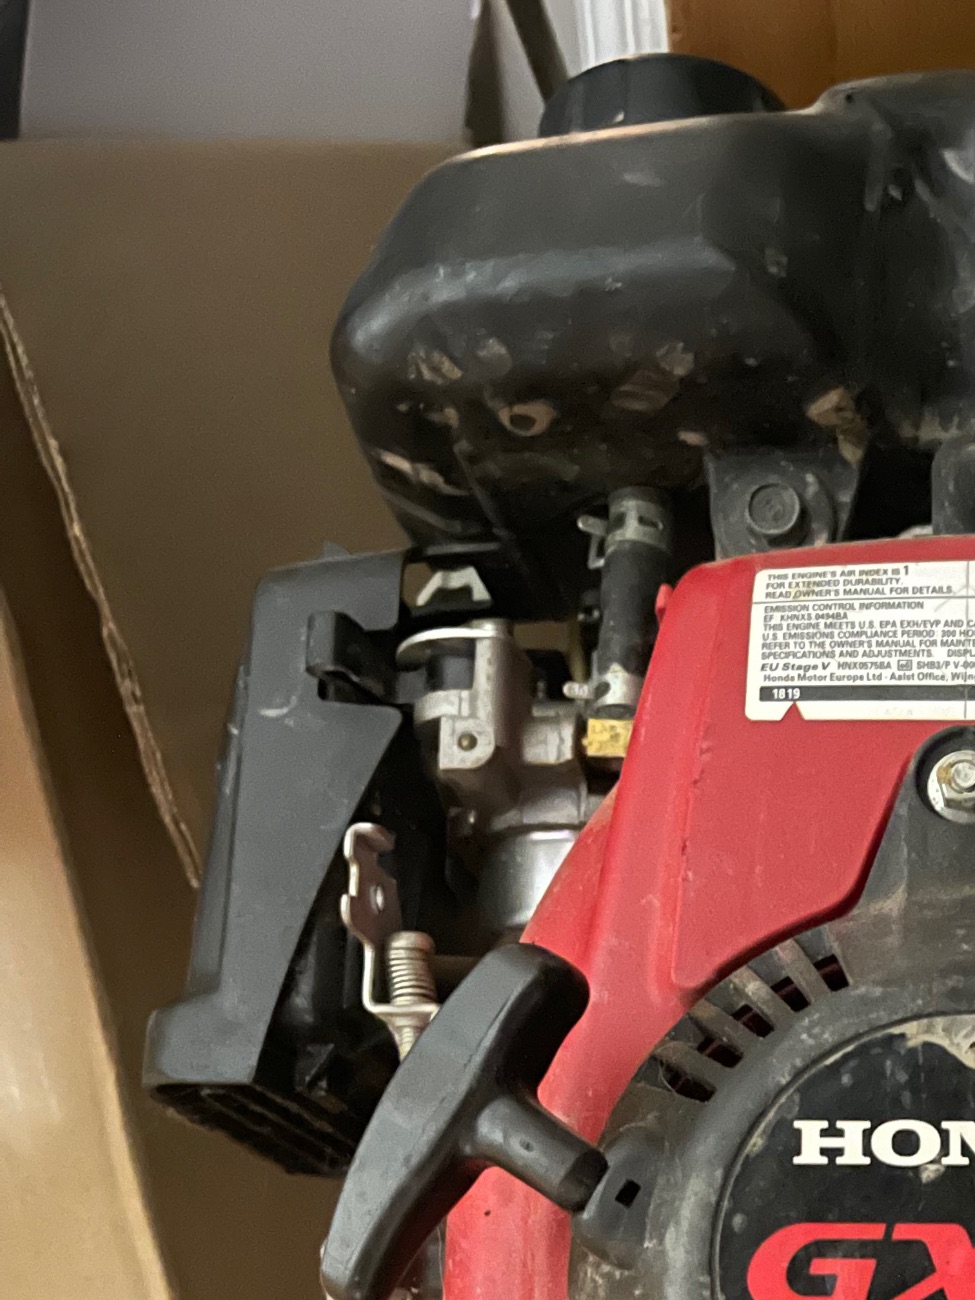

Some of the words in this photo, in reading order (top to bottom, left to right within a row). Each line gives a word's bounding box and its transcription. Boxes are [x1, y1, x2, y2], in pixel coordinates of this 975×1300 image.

[791, 570, 837, 580] ENGINE'S
[839, 570, 856, 578] AIR
[858, 568, 888, 577] INDEX
[891, 568, 900, 576] IS
[903, 565, 909, 575] 1
[766, 582, 785, 590] FOR
[788, 579, 840, 589] EXTENDED
[765, 591, 791, 599] READ
[792, 589, 840, 599] OWNER'S
[843, 587, 886, 596] MANUAL
[889, 586, 909, 595] FOR
[764, 604, 809, 613] EMISSION
[812, 602, 856, 611] CONTROL
[859, 601, 924, 610] INFORMATION
[763, 623, 783, 631] THIS
[786, 622, 821, 631] ENGINE
[824, 621, 855, 629] MEETS
[879, 620, 897, 628] EPA
[900, 619, 941, 628] EXH/EVP
[943, 619, 964, 628] AND
[783, 631, 835, 640] EMISSIONS
[838, 630, 898, 639] COMPLIANCE
[761, 641, 790, 650] REFER
[793, 640, 805, 649] TO
[809, 640, 826, 649] THE
[829, 640, 872, 649] OWNER'S
[875, 639, 916, 648] MANUAL
[919, 639, 938, 648] FOR
[761, 650, 836, 660] SPECIFICATIONS
[838, 650, 859, 658] AND
[760, 662, 779, 672] EU
[782, 662, 818, 673] Stage
[821, 662, 831, 671] V
[764, 673, 795, 682] Honda
[797, 672, 827, 682] Motor
[829, 672, 864, 683] Europe
[867, 672, 882, 681] Ltd
[917, 672, 948, 682] Office,
